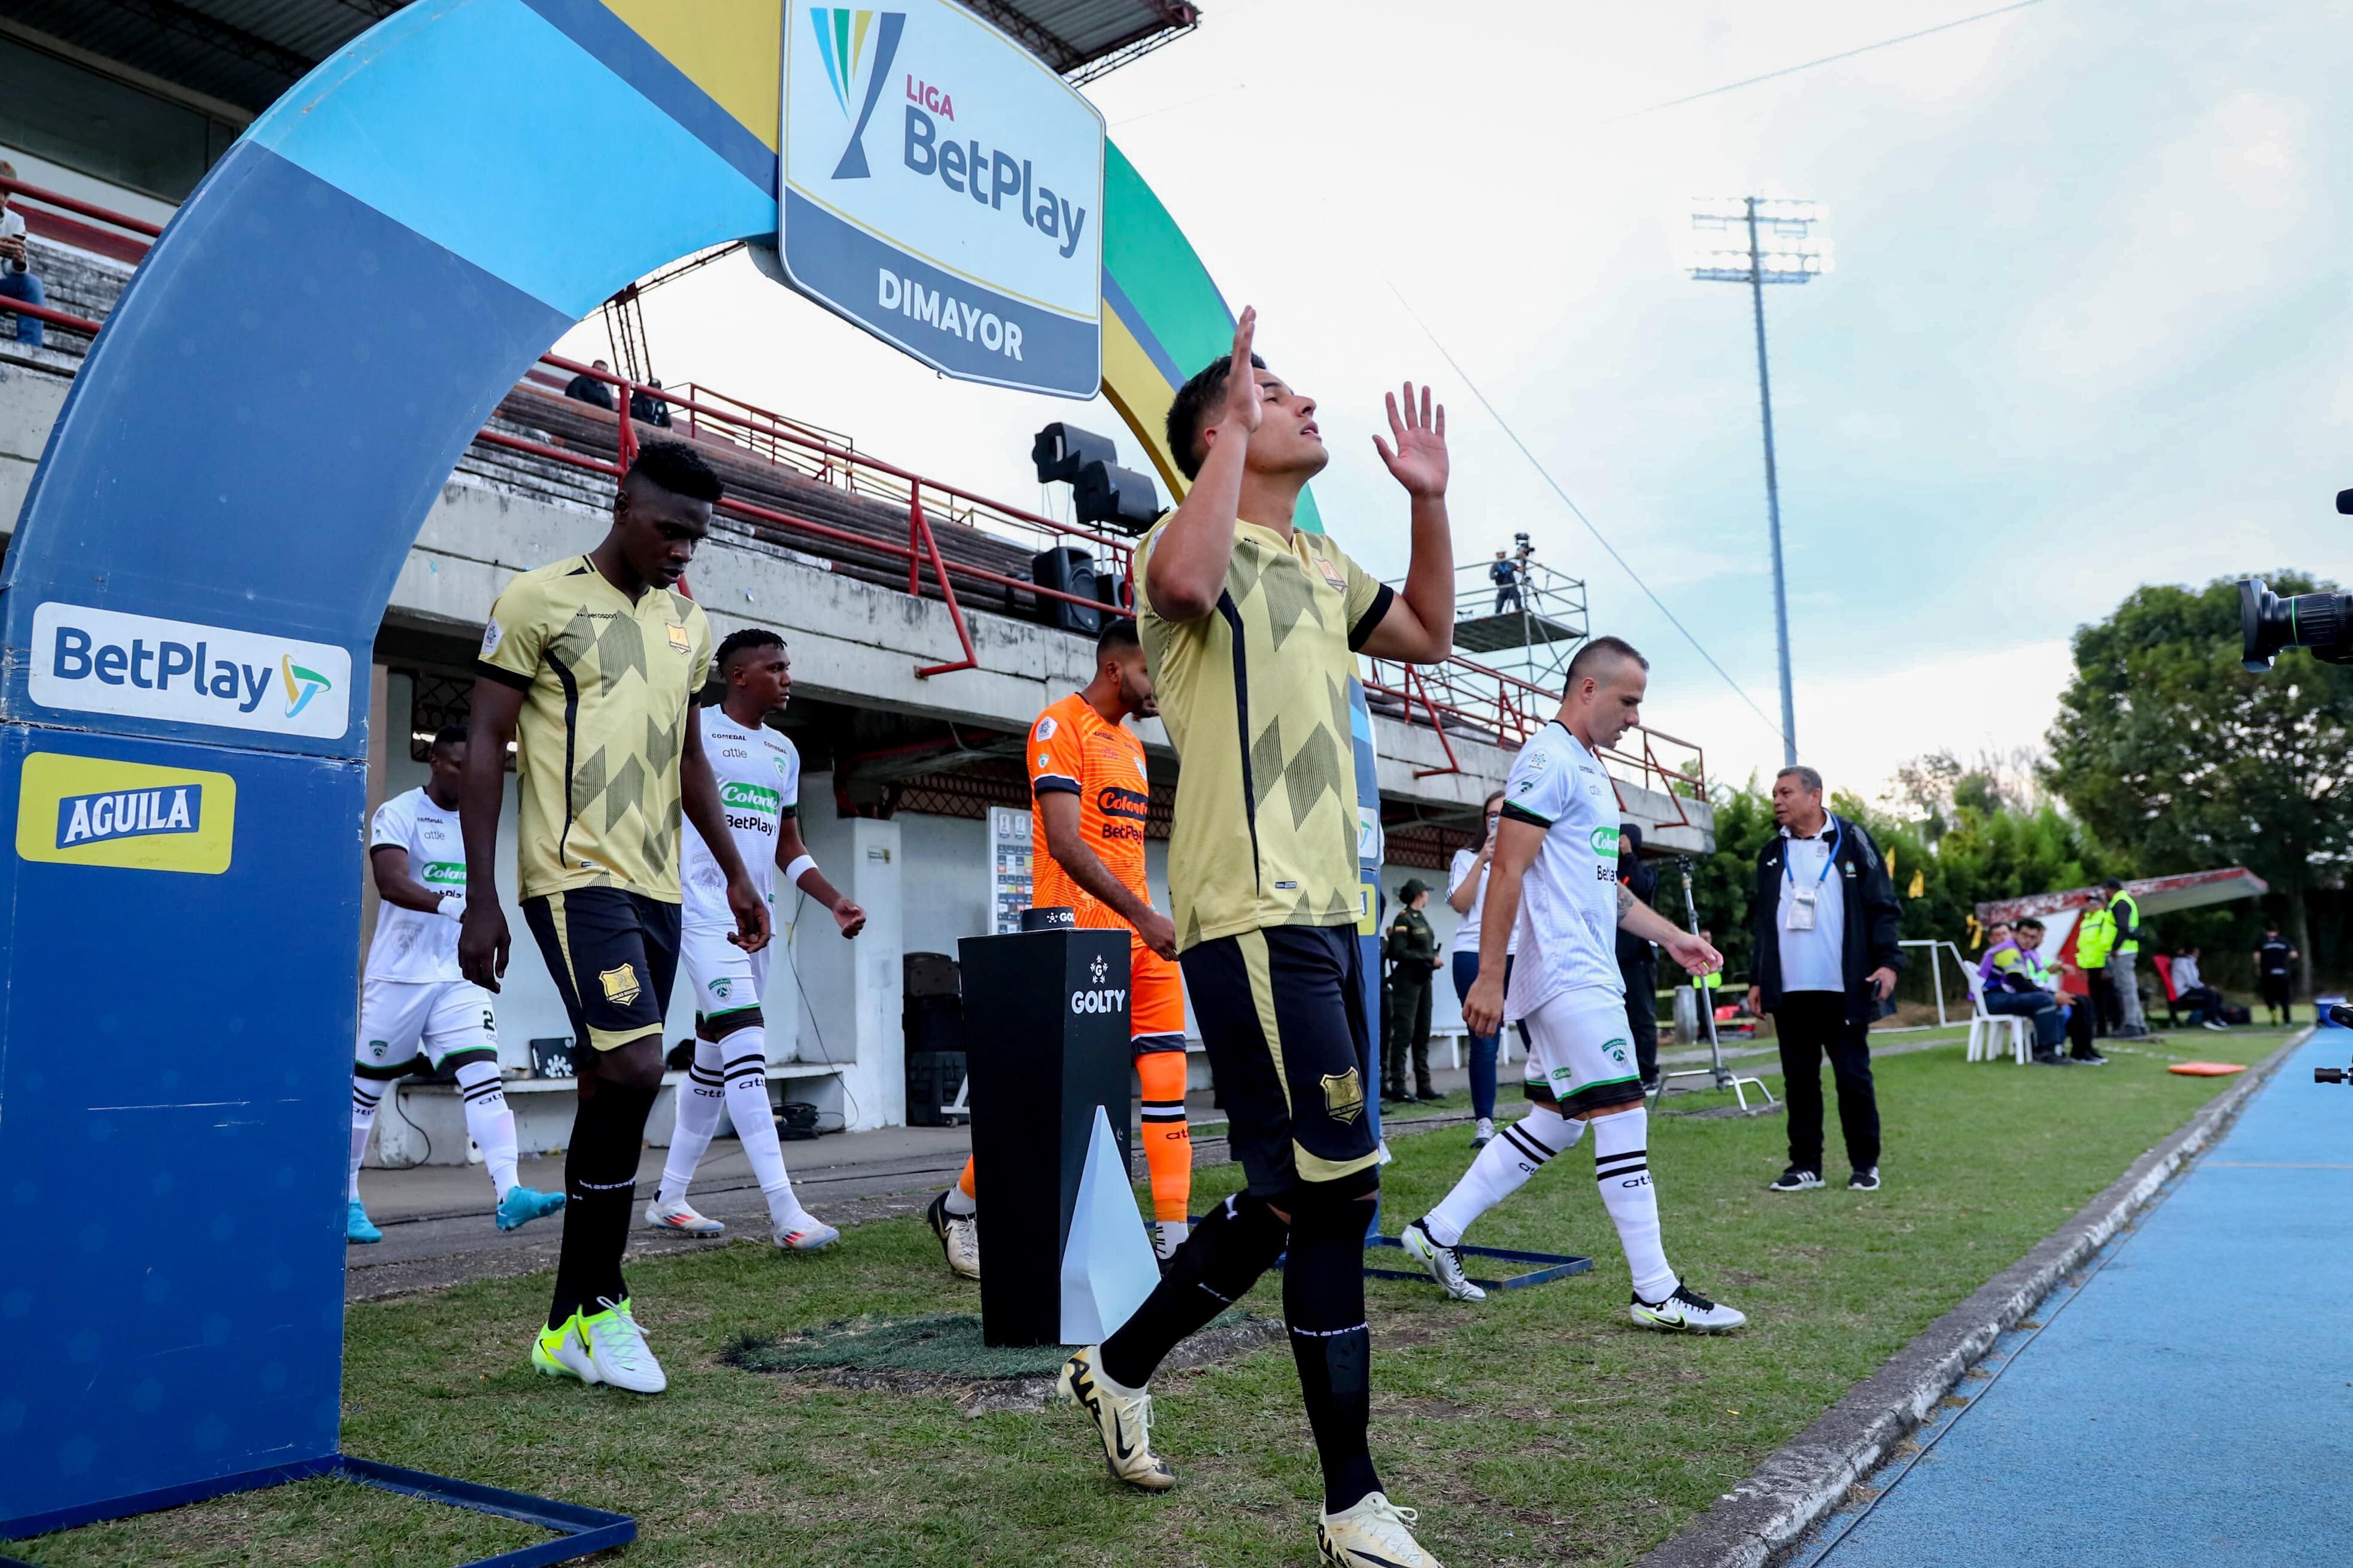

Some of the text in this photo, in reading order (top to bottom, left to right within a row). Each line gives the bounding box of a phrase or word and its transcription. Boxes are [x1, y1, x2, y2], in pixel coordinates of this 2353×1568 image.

[906, 74, 955, 122] LIGA
[904, 104, 1086, 259] BetPlay
[879, 268, 1024, 362] DIMAYOR
[53, 626, 274, 713] BetPlay
[63, 789, 192, 844] AGUILA
[1102, 823, 1143, 845] BetPay
[482, 1010, 496, 1032] 2
[1071, 989, 1126, 1014] GOLTY
